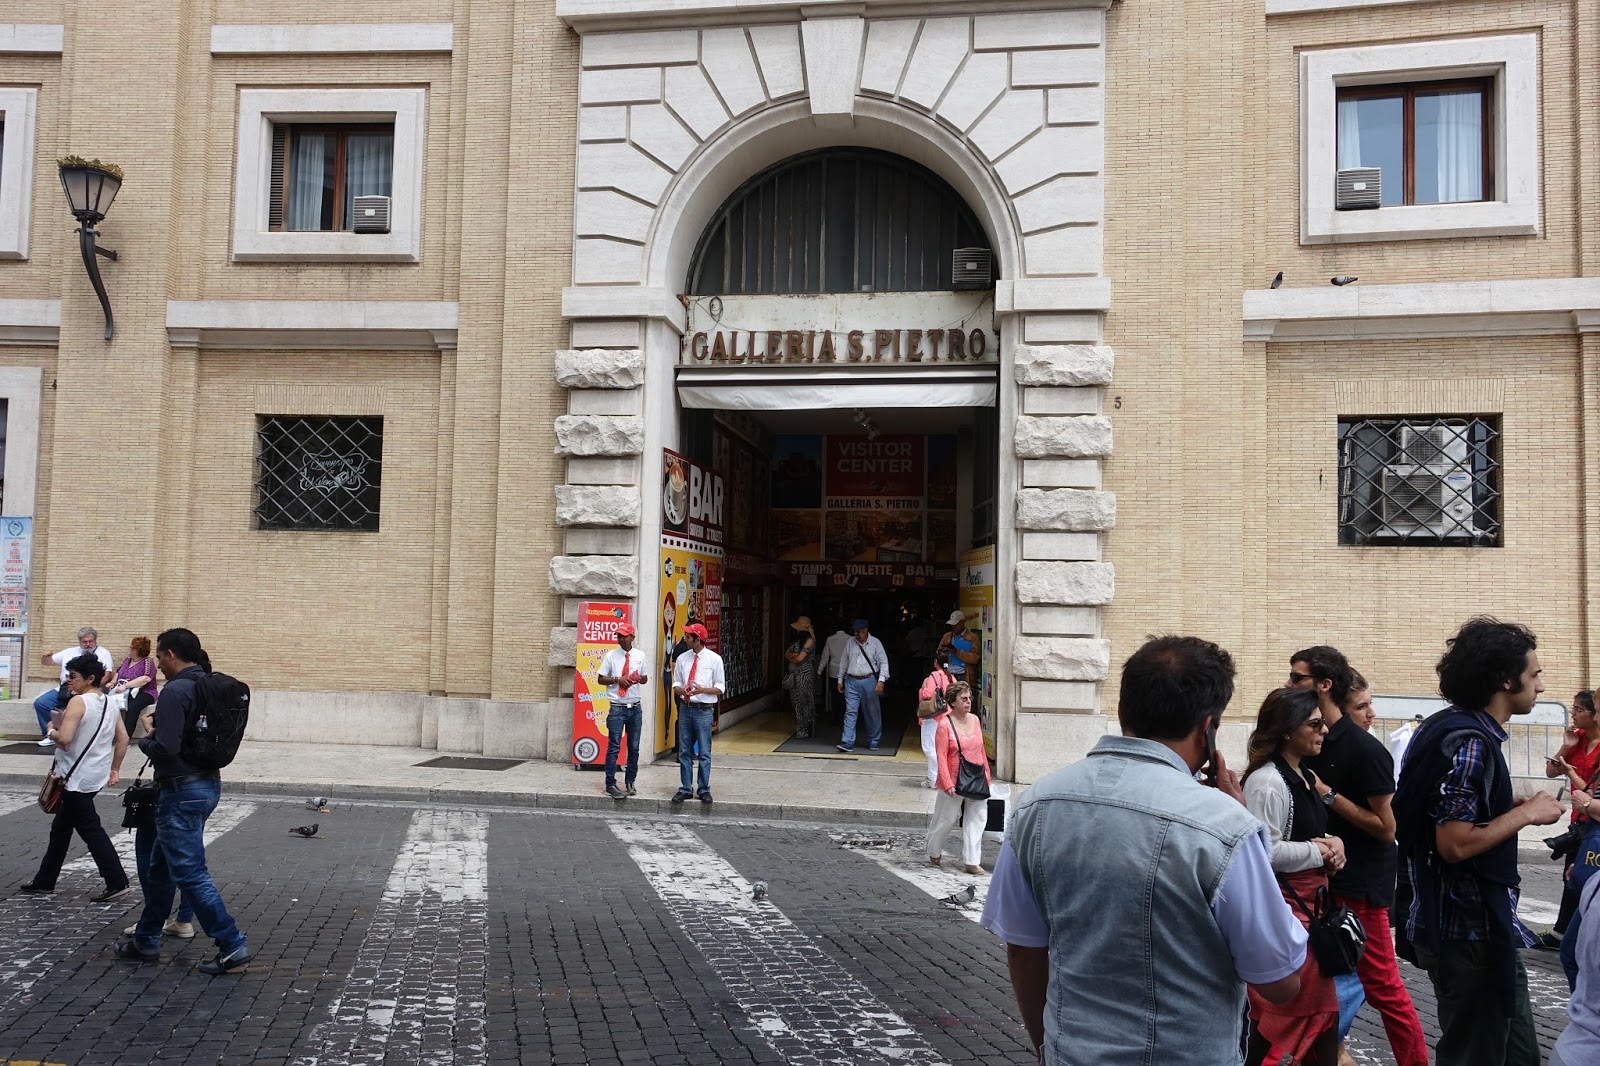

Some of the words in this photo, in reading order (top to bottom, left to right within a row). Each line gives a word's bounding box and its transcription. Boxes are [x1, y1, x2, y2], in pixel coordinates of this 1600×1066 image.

[692, 330, 837, 362] GALLERIA
[1115, 396, 1122, 410] 5
[838, 440, 913, 457] VISITOR
[837, 458, 913, 473] CENTER
[690, 464, 724, 527] BAR
[828, 498, 872, 510] GALLERIA
[886, 498, 920, 510] PIETRO
[791, 564, 833, 575] STAMPS
[845, 564, 892, 576] TOILETTE
[905, 564, 935, 577] BAR
